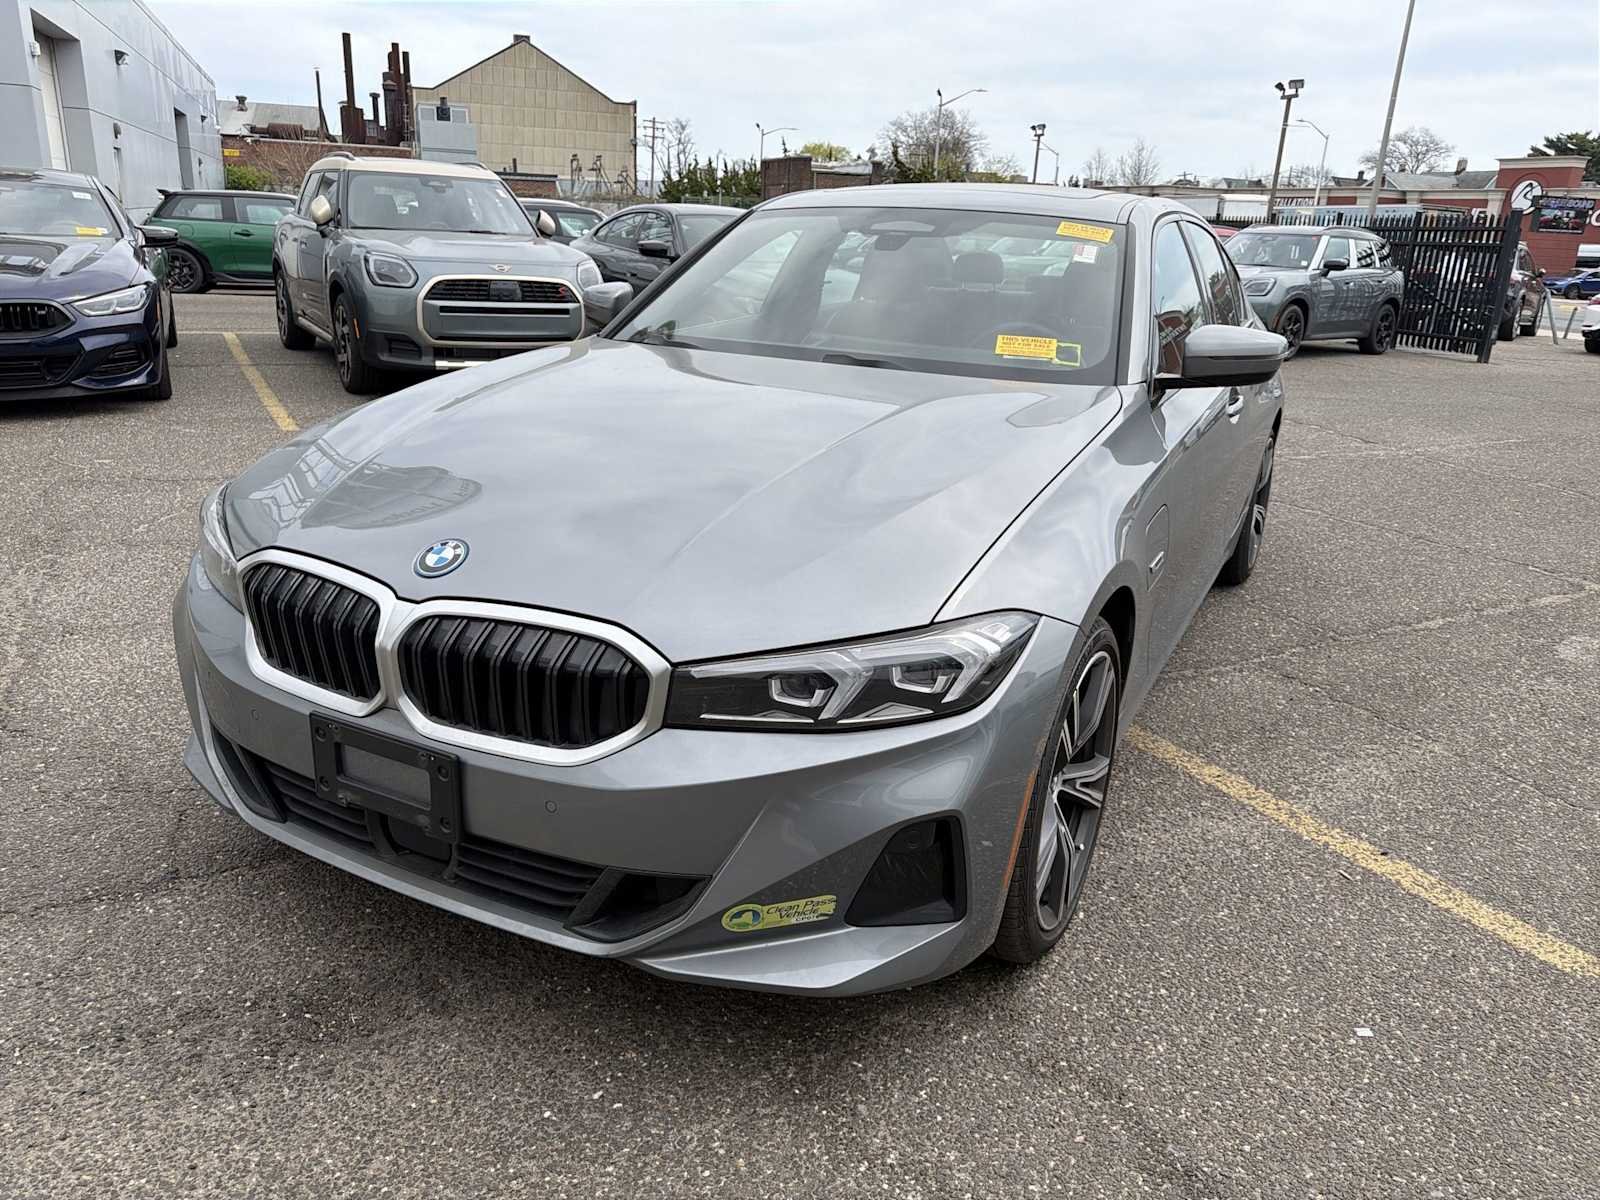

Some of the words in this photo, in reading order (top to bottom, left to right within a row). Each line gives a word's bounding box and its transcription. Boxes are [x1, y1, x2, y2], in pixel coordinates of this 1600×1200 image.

[1020, 337, 1052, 345] VEHICLE
[766, 902, 800, 915] Clean
[804, 897, 837, 910] Pass
[779, 907, 819, 920] Vehicle
